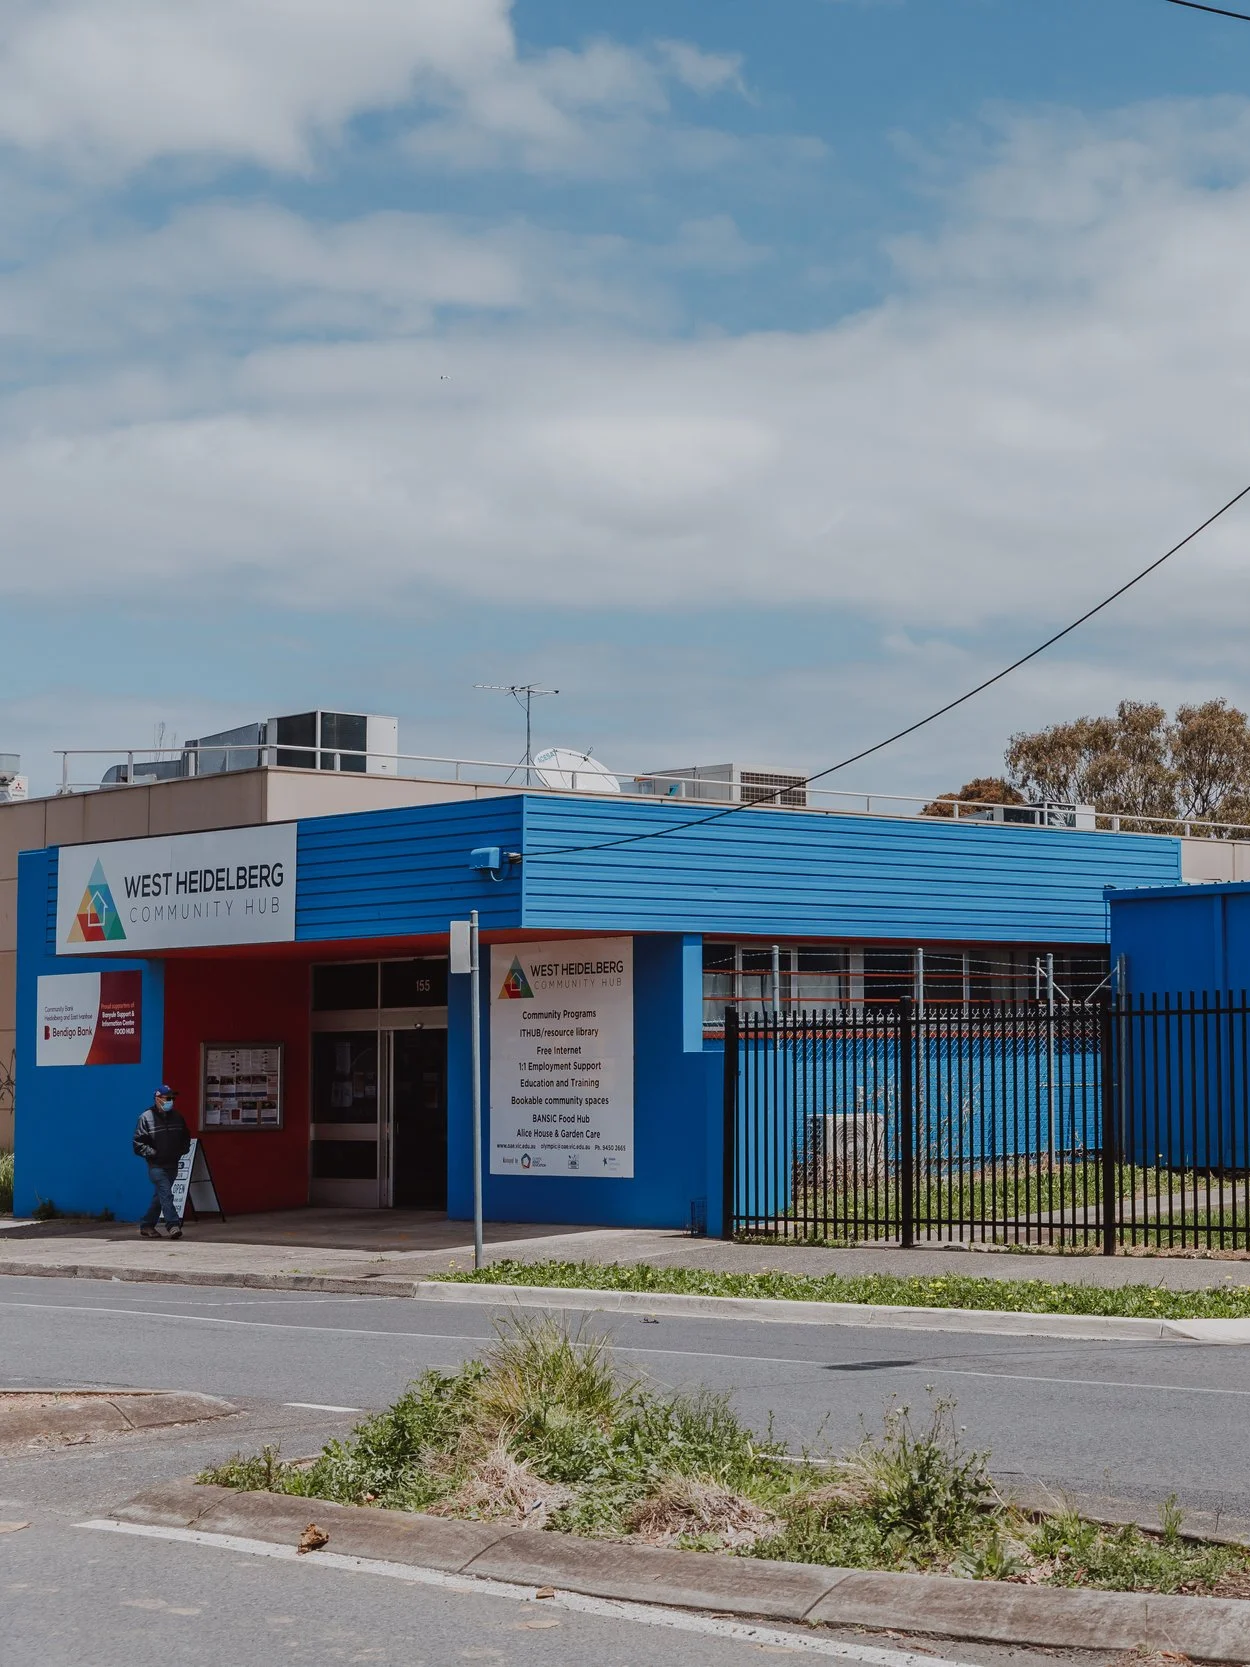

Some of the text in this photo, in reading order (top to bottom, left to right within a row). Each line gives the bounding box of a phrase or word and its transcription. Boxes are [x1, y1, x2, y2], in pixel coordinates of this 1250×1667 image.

[124, 862, 284, 899] WEST HEIDELBERG
[129, 896, 280, 923] COMMUNITY HUB
[530, 960, 624, 977] WEST HEIDELBERG
[416, 979, 430, 992] 155
[534, 977, 622, 990] COMMUNITY HUB
[522, 1009, 597, 1020] Community Programs
[53, 1027, 76, 1039] Bendigo
[77, 1026, 92, 1036] Bank
[576, 1027, 598, 1038] library
[536, 1046, 582, 1055] Free Internet
[528, 1062, 571, 1072] Employment
[573, 1061, 601, 1071] Support
[520, 1078, 600, 1088] Education and Training
[511, 1096, 609, 1106] Bookable community spaces
[532, 1114, 590, 1123] BANSIC Food Hub
[516, 1129, 601, 1138] Alice House & Garden Care
